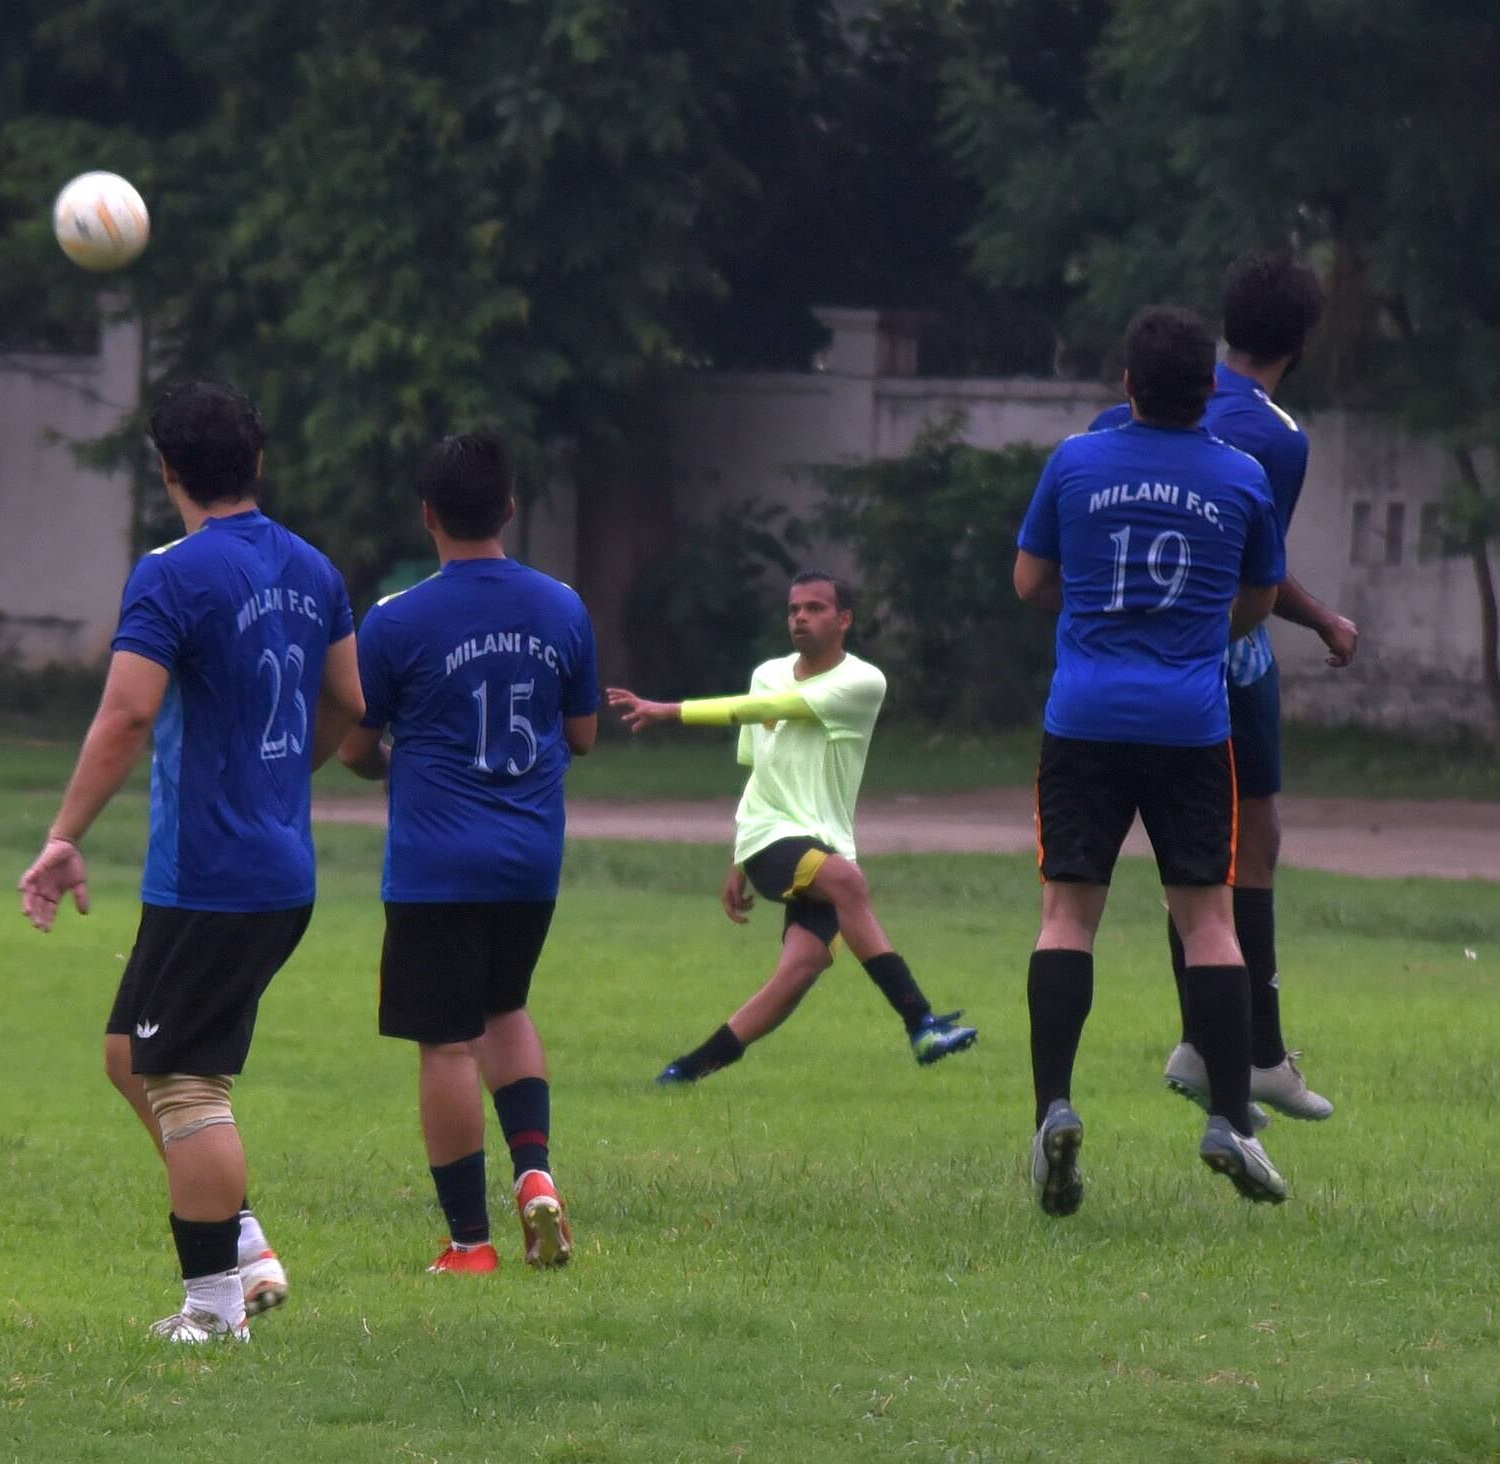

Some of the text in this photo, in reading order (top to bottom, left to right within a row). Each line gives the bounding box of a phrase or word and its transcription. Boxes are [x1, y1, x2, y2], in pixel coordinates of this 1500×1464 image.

[1089, 482, 1225, 532] MILANI F.C.
[1102, 525, 1191, 613] 19
[445, 632, 560, 676] MILANI F.C.
[257, 643, 308, 760] 23
[468, 678, 538, 777] 15
